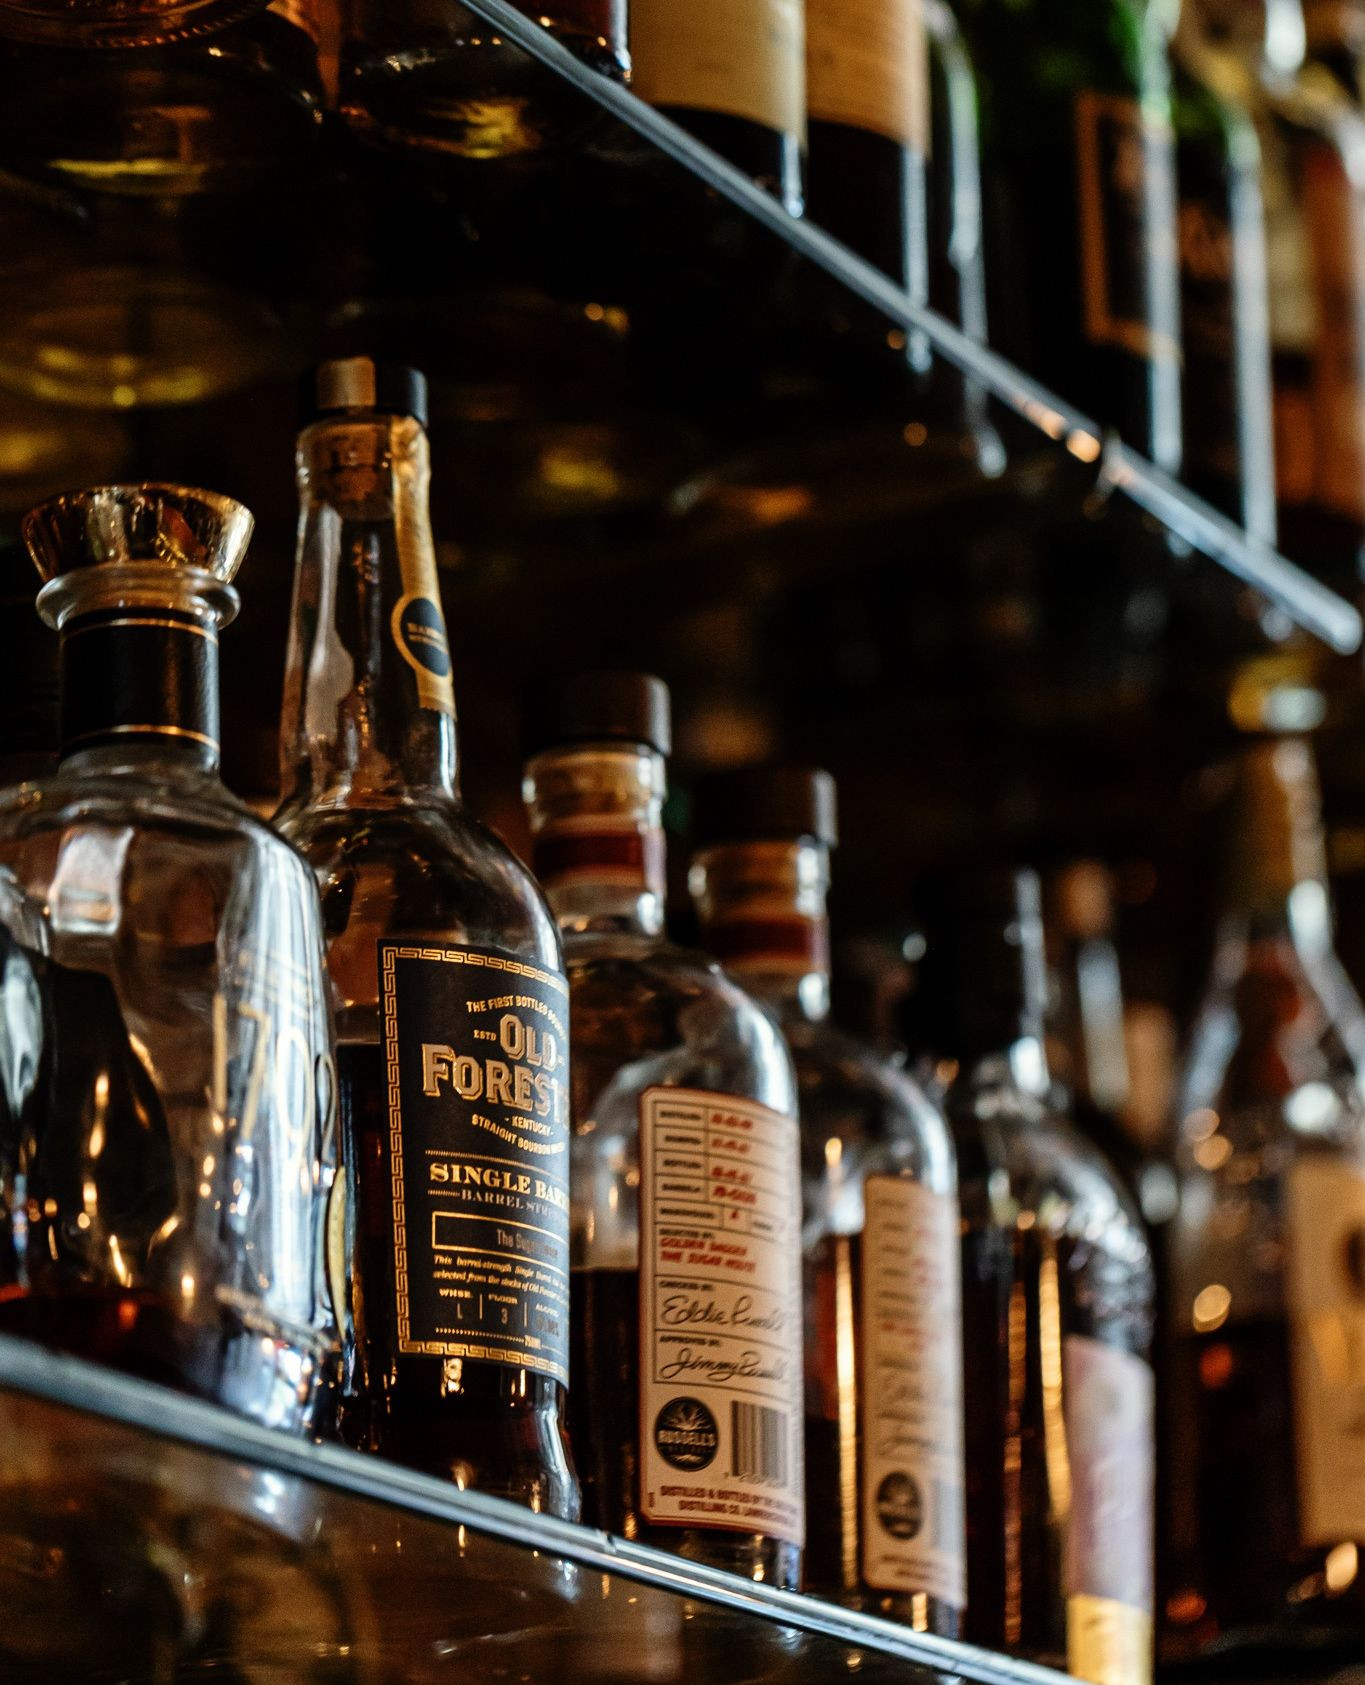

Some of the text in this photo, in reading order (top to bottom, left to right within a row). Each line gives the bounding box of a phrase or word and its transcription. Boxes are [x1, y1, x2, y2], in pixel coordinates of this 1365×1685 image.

[466, 1001, 487, 1013] THE
[487, 996, 514, 1010] FIRST
[500, 1013, 557, 1073] OLD
[471, 1113, 518, 1144] STRAIGHT
[511, 1115, 552, 1137] KENTUCKY
[429, 1162, 531, 1195] SINGLE
[461, 1189, 524, 1209] BARREL
[434, 1254, 453, 1265] This
[466, 1271, 487, 1284] from
[500, 1307, 508, 1325] 3
